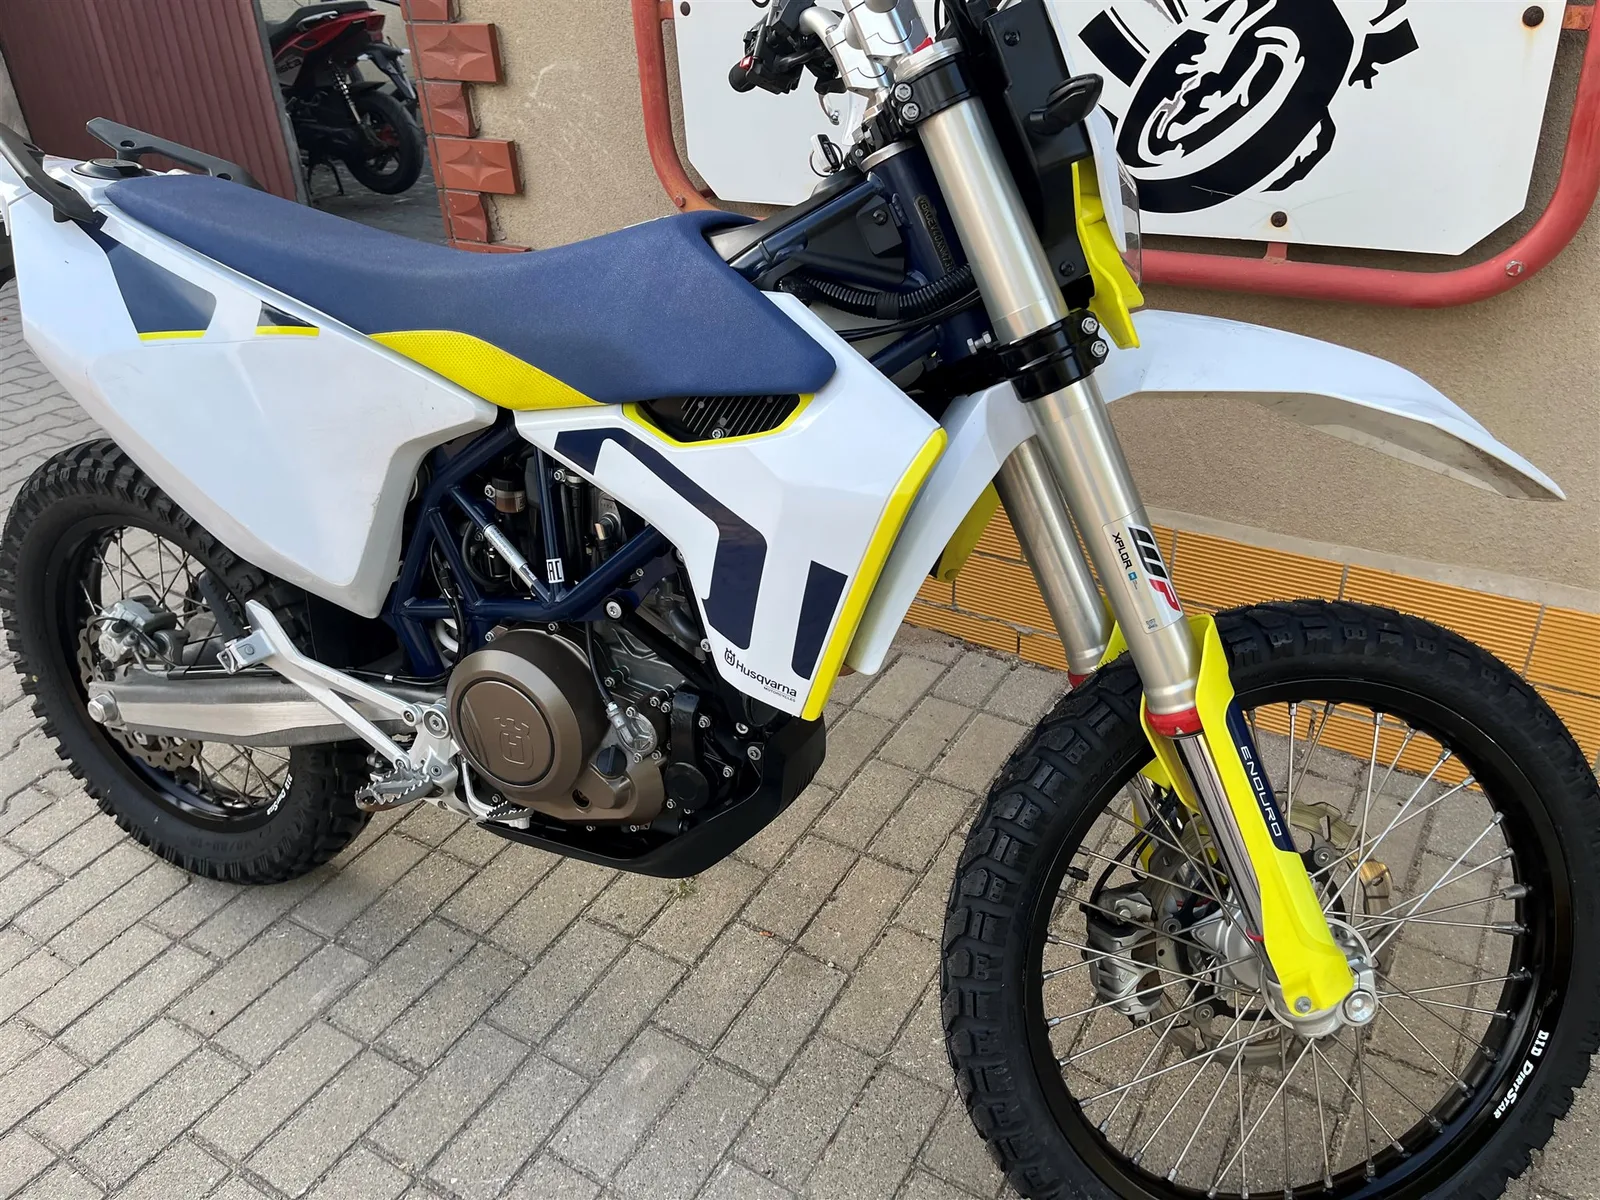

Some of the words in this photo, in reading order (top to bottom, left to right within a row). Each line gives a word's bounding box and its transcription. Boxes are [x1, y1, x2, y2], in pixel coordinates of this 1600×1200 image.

[1112, 532, 1133, 570] XPLOR
[735, 659, 797, 698] Husqvarna
[1240, 745, 1282, 837] ENDURO
